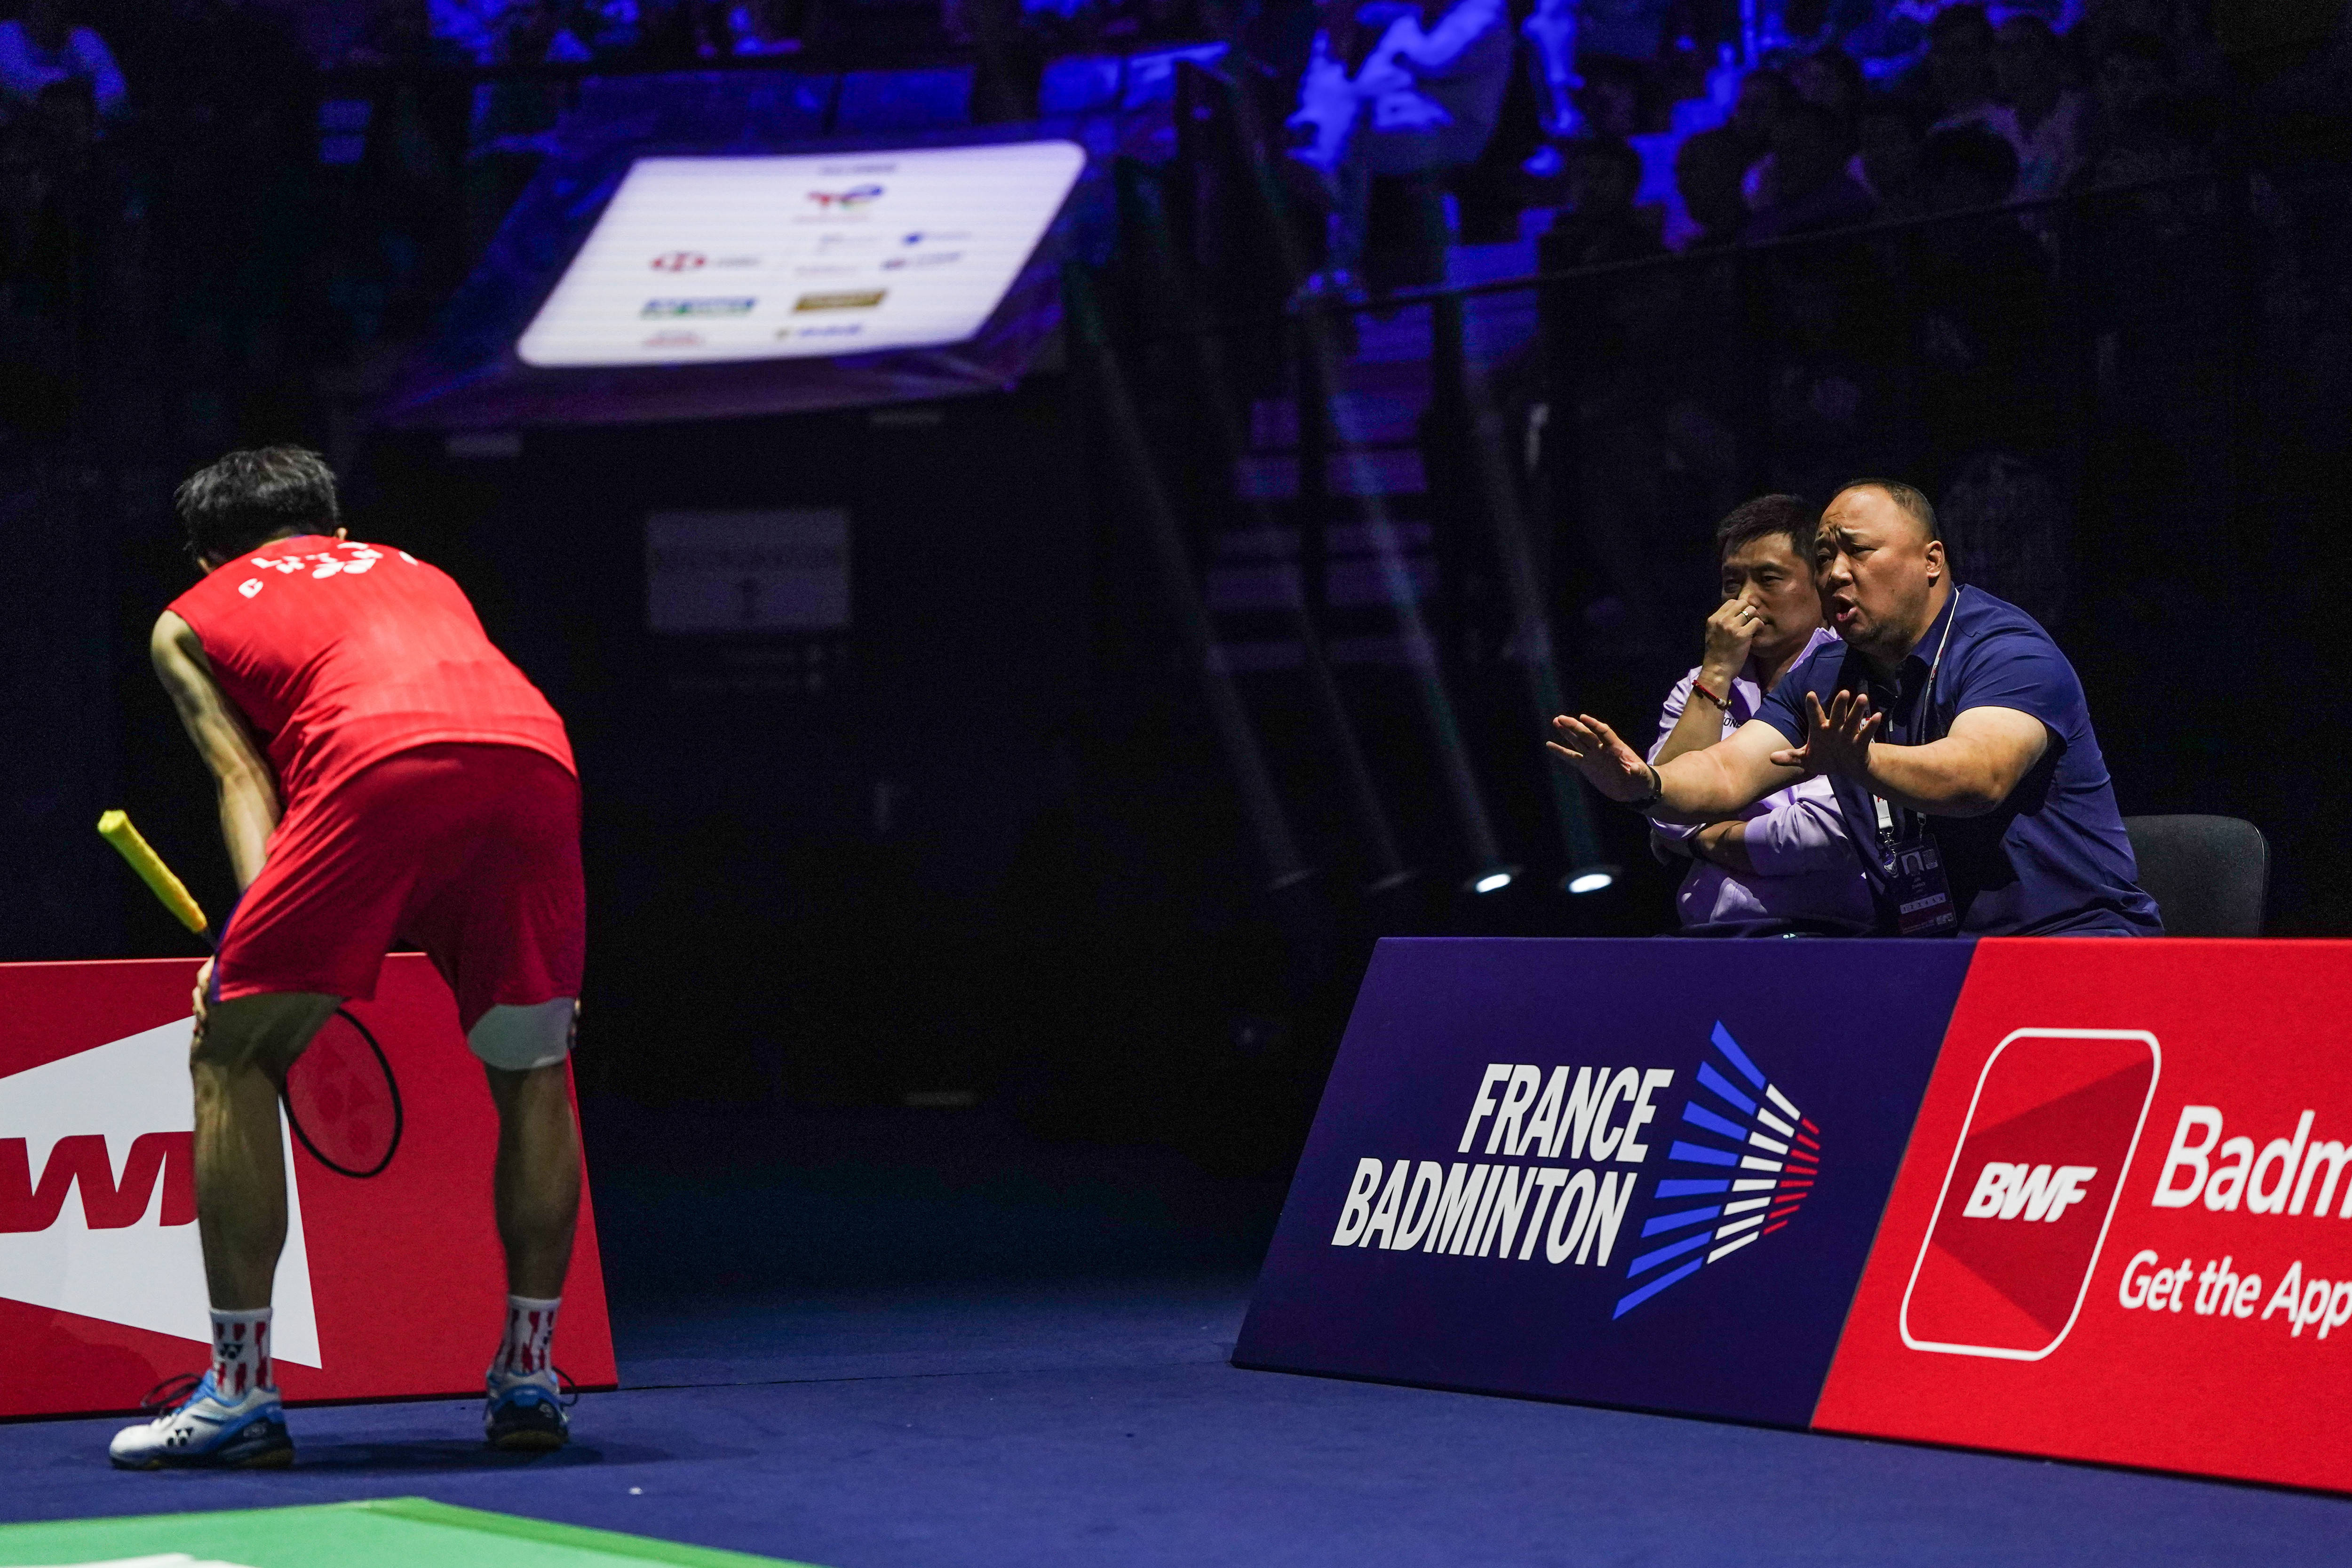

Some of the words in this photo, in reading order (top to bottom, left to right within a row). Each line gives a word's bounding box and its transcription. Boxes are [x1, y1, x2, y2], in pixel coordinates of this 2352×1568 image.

[1457, 1063, 1675, 1162] FRANCE
[1331, 1157, 1637, 1266] BADMINTON
[1962, 1162, 2098, 1222] BWF
[2119, 1250, 2193, 1313] Get
[2194, 1256, 2262, 1318] the
[2261, 1260, 2352, 1339] App
